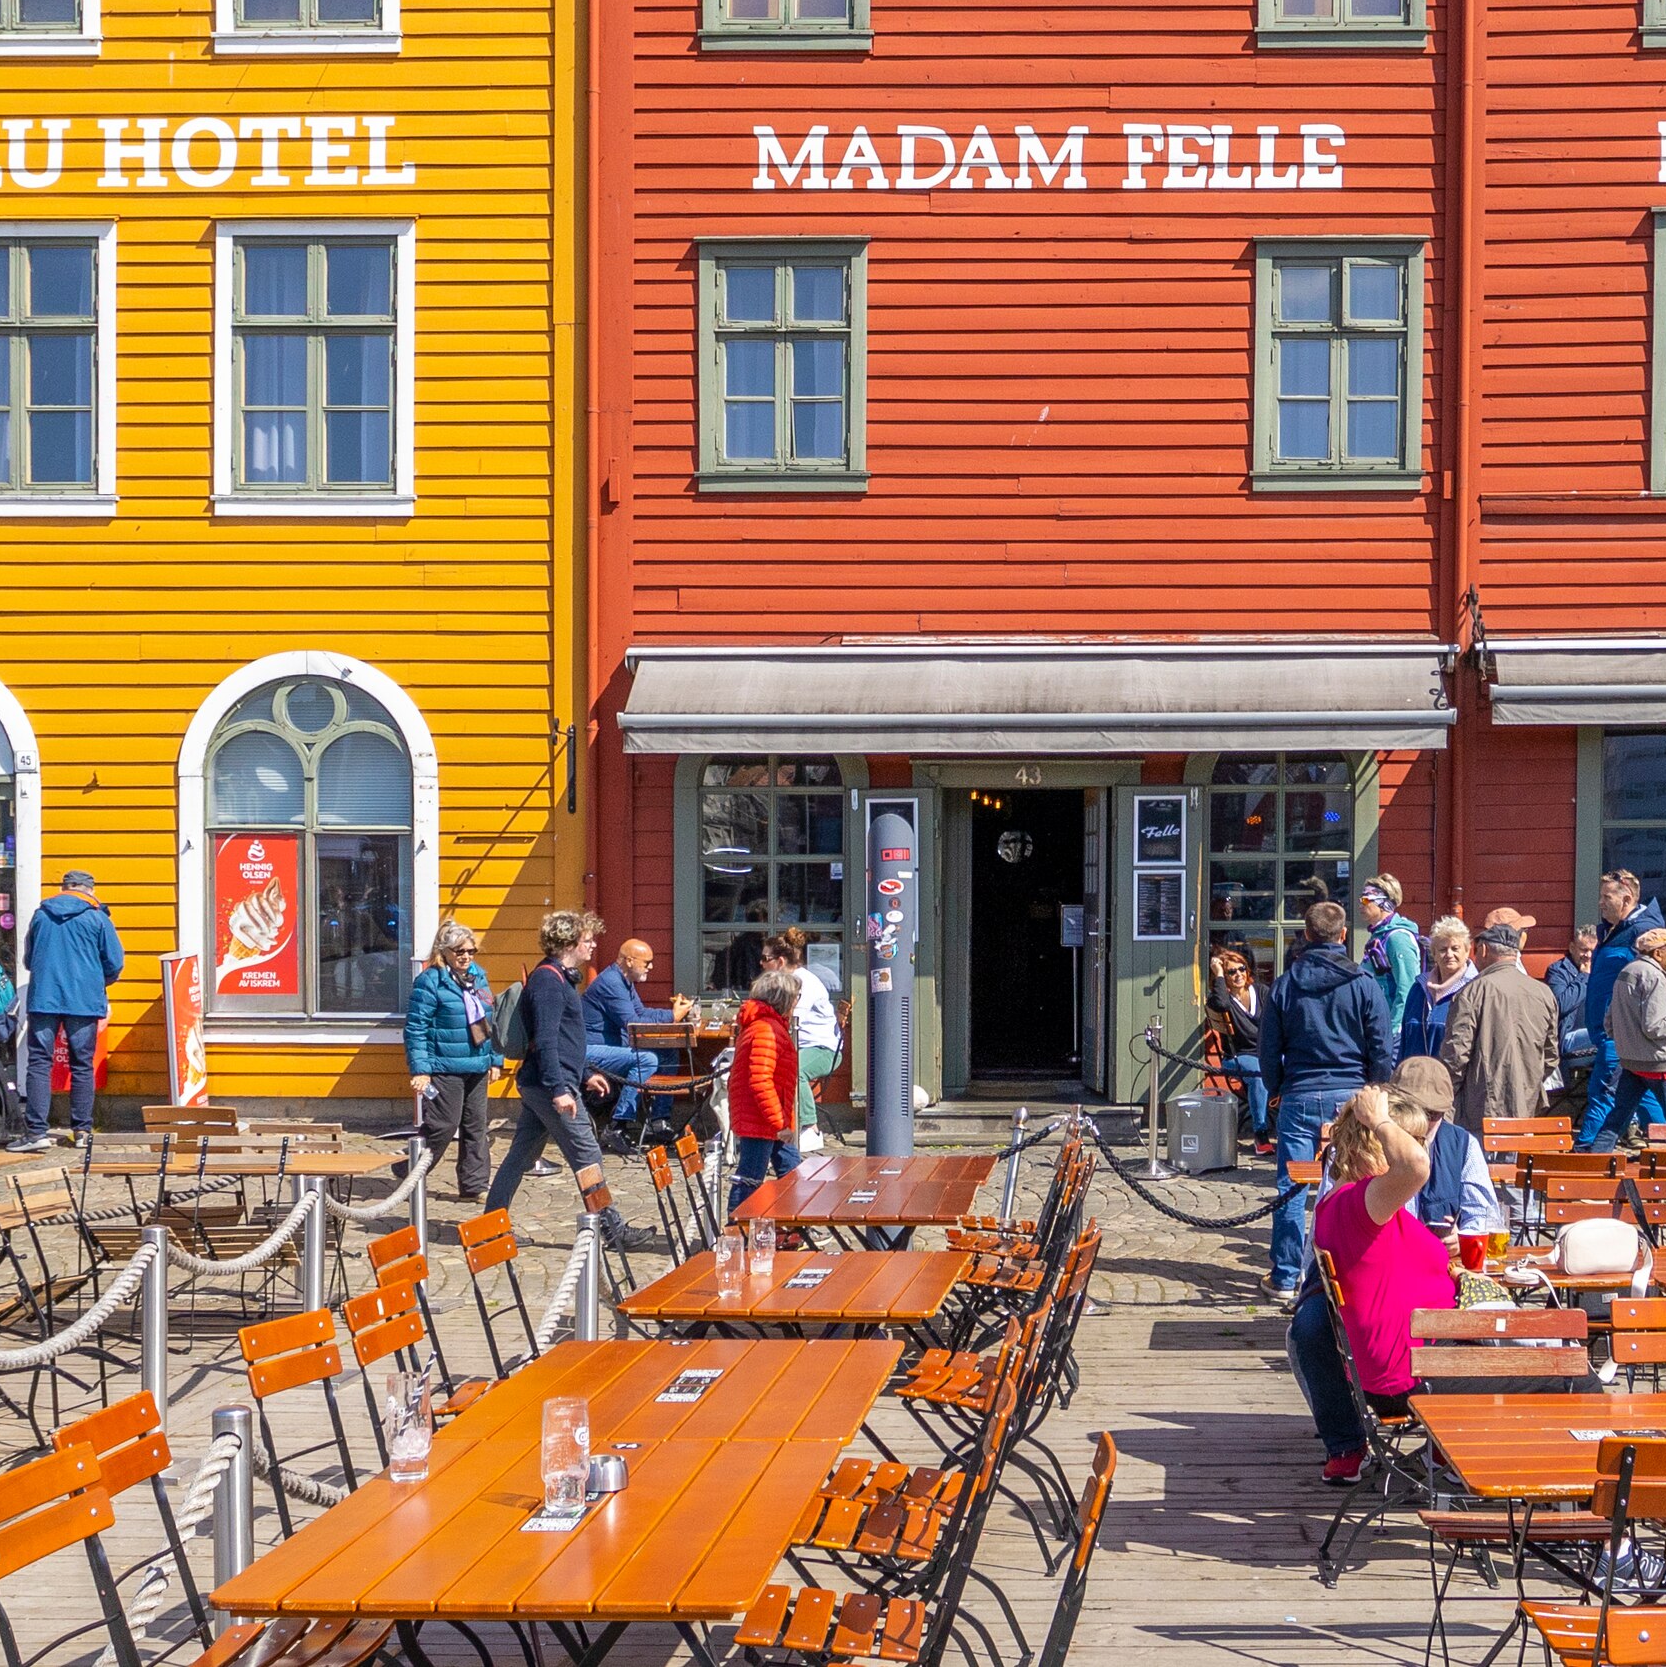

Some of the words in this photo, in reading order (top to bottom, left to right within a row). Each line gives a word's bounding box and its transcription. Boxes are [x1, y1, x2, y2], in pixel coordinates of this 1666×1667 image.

[97, 116, 417, 188] HOTEL
[752, 124, 1090, 190] MADAM
[1121, 123, 1346, 189] FELLE
[20, 755, 32, 766] 45
[1014, 766, 1042, 785] 43
[1141, 824, 1180, 838] Felle
[239, 863, 273, 871] HENNIG
[242, 871, 271, 879] OLSEN
[242, 971, 277, 980] KREMEN
[238, 979, 250, 988] AV
[250, 979, 281, 988] ISKREM
